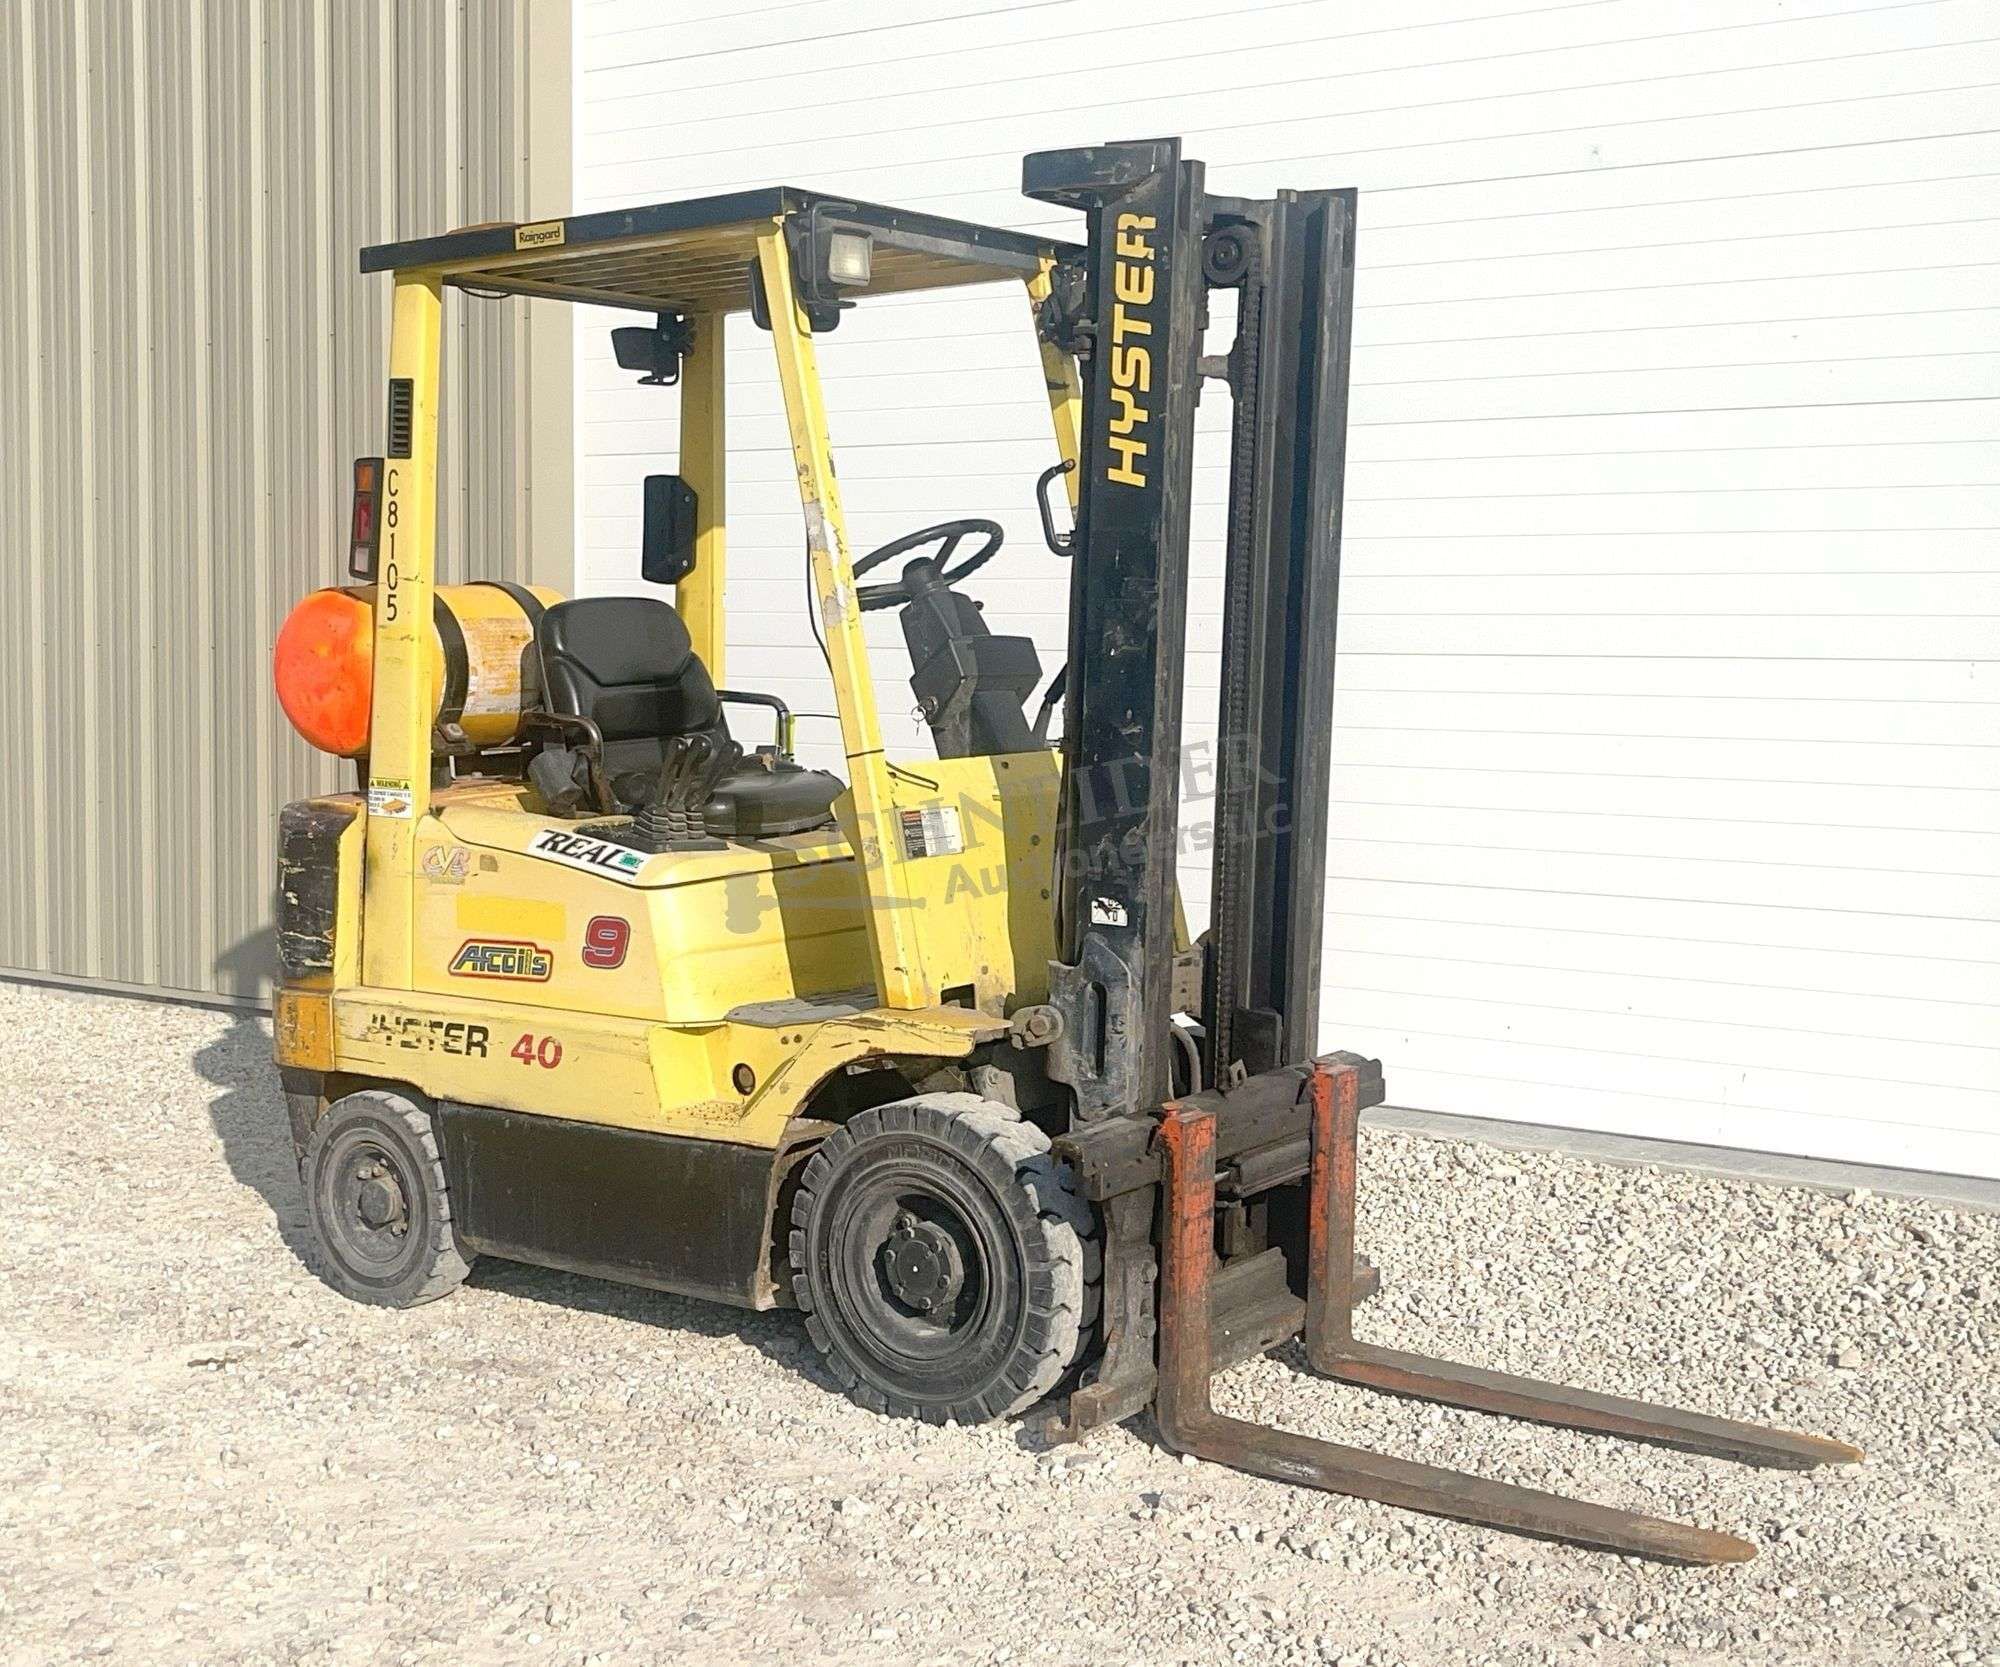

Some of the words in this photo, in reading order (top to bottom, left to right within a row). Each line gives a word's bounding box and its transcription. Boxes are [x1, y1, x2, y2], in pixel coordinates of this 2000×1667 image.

[519, 225, 561, 245] Raingard
[1107, 212, 1157, 488] HYSTER
[536, 829, 638, 876] REAL
[581, 916, 631, 969] 9
[510, 1033, 563, 1070] 40
